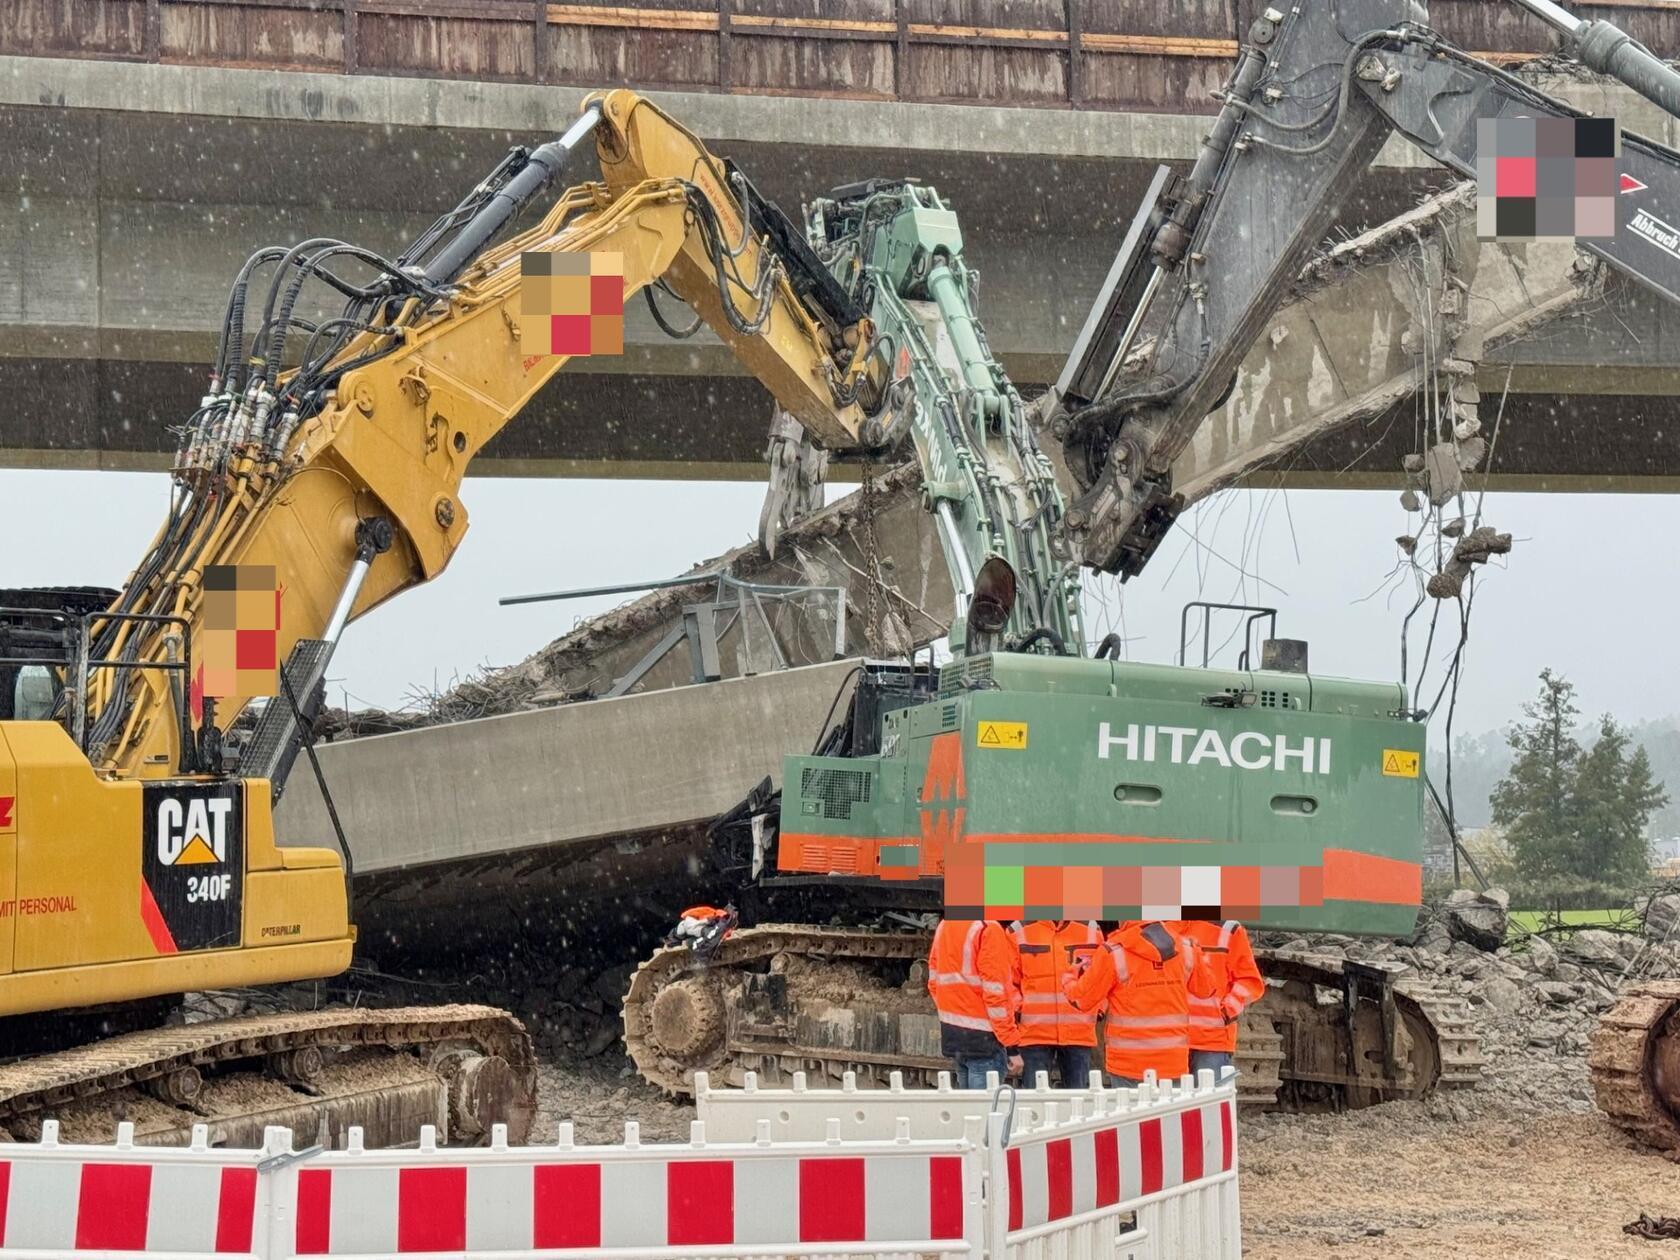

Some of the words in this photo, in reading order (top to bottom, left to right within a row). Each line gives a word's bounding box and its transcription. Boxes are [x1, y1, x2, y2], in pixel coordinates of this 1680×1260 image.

[1631, 213, 1679, 250] Abbruch
[1098, 722, 1331, 774] HITACHI
[158, 798, 231, 866] CAT
[20, 895, 77, 915] PERSONAL
[187, 874, 231, 903] 340F
[261, 924, 301, 938] CATERPILLAR
